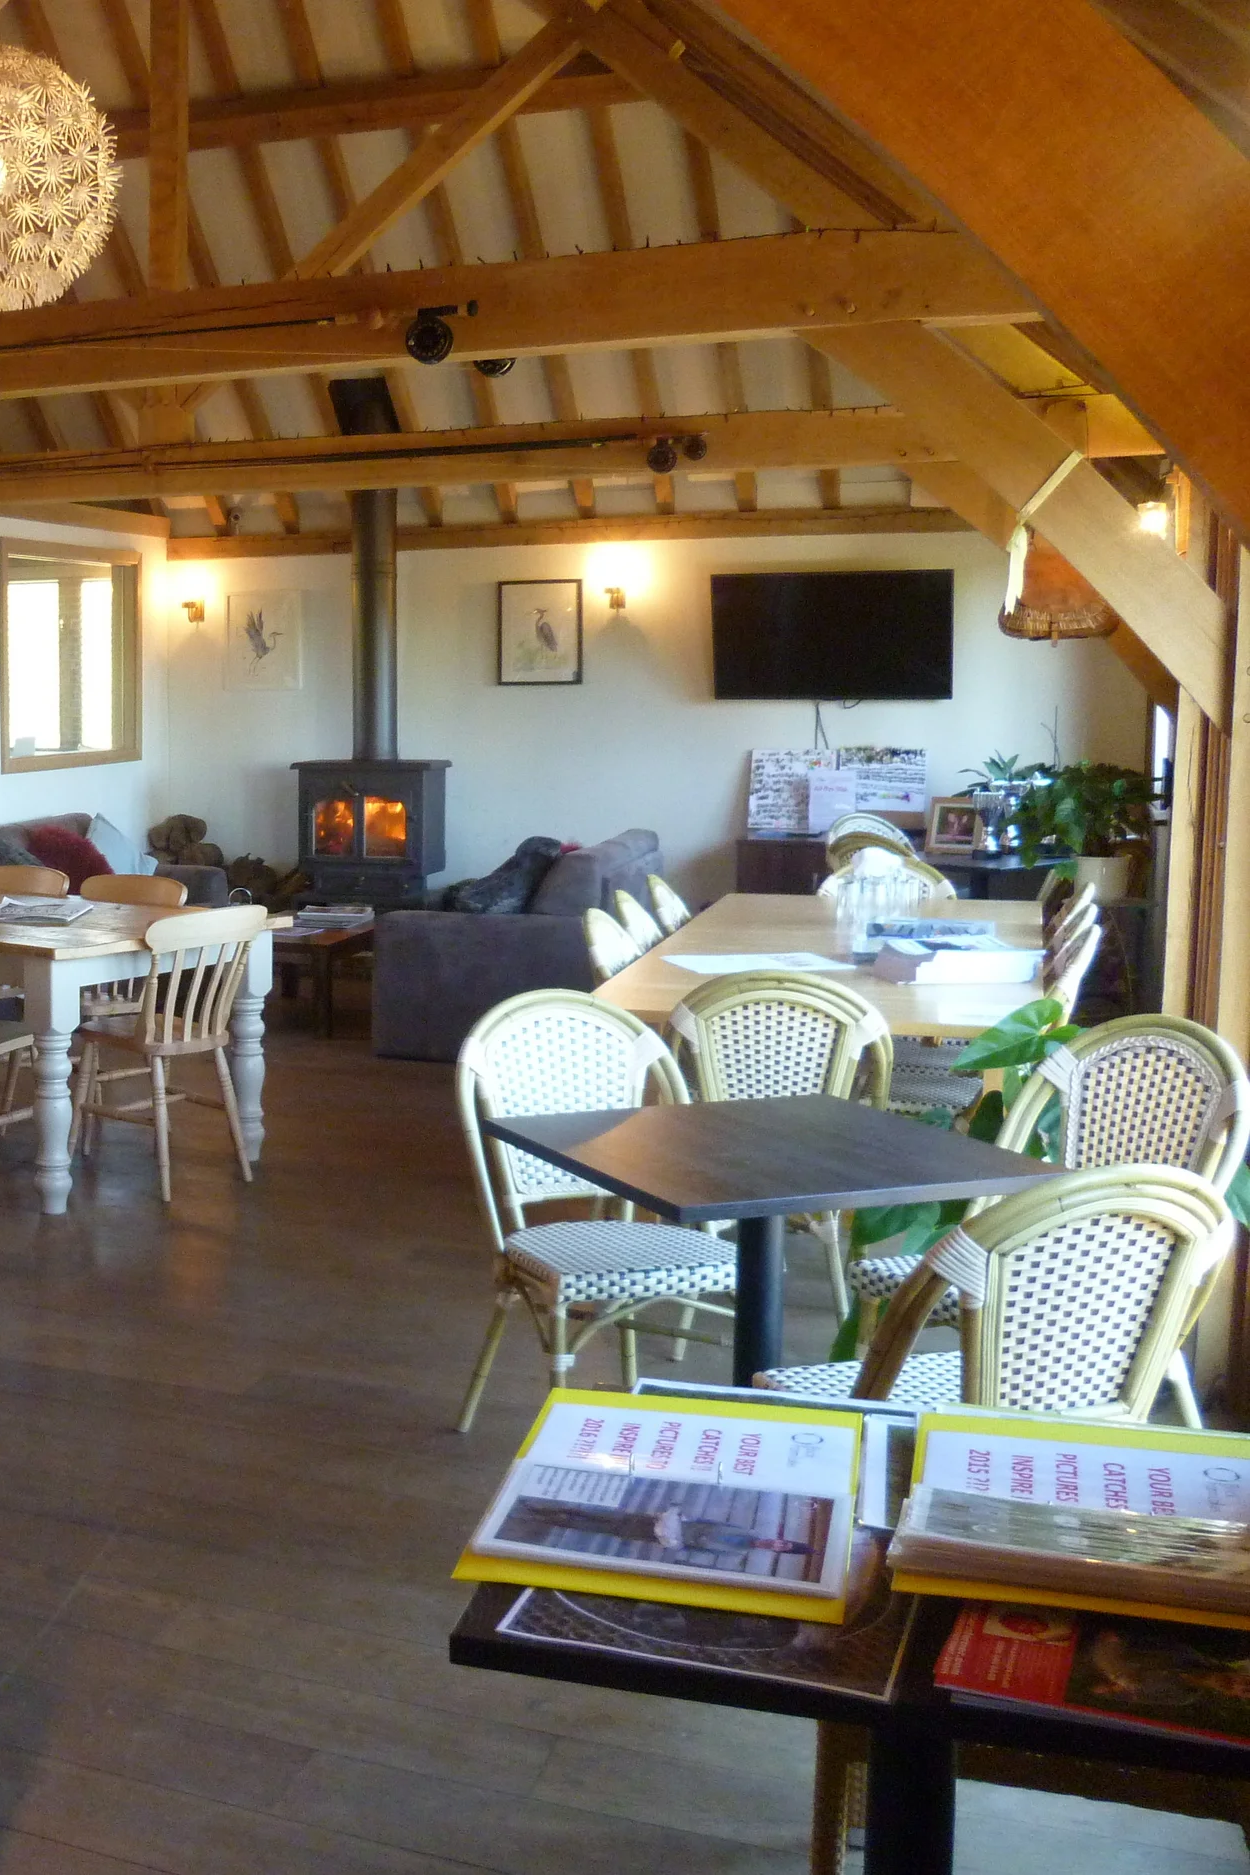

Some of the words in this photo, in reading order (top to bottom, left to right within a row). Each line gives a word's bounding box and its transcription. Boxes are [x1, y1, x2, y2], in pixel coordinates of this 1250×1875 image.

[578, 1418, 605, 1437] 2016
[612, 1422, 641, 1453] INSPIRE
[650, 1421, 682, 1459] PICTURES
[694, 1429, 723, 1465] CATCHES
[737, 1433, 762, 1456] YOUR
[733, 1458, 756, 1476] BEST
[967, 1449, 991, 1474] 2015
[1010, 1455, 1034, 1494] INSPIRE
[1054, 1453, 1079, 1503] PICTURES
[1103, 1462, 1129, 1510] CATCHES
[1147, 1467, 1174, 1497] YOUR
